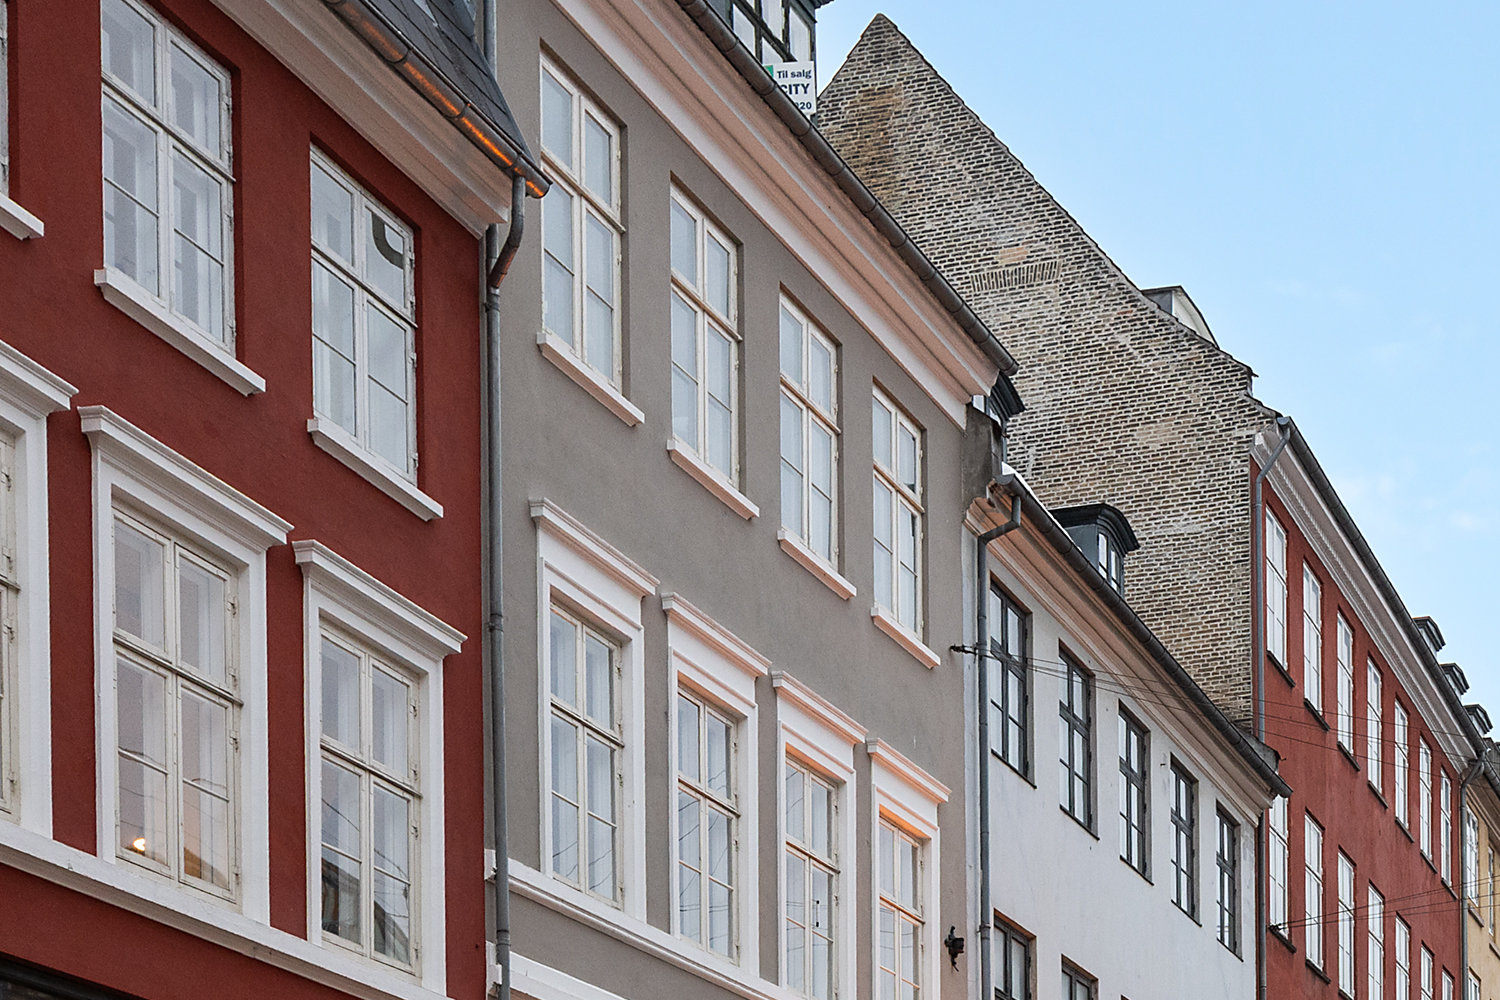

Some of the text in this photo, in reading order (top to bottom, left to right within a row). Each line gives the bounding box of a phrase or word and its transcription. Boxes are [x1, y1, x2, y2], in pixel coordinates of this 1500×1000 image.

[777, 69, 812, 79] Til salg
[780, 83, 810, 95] CITY
